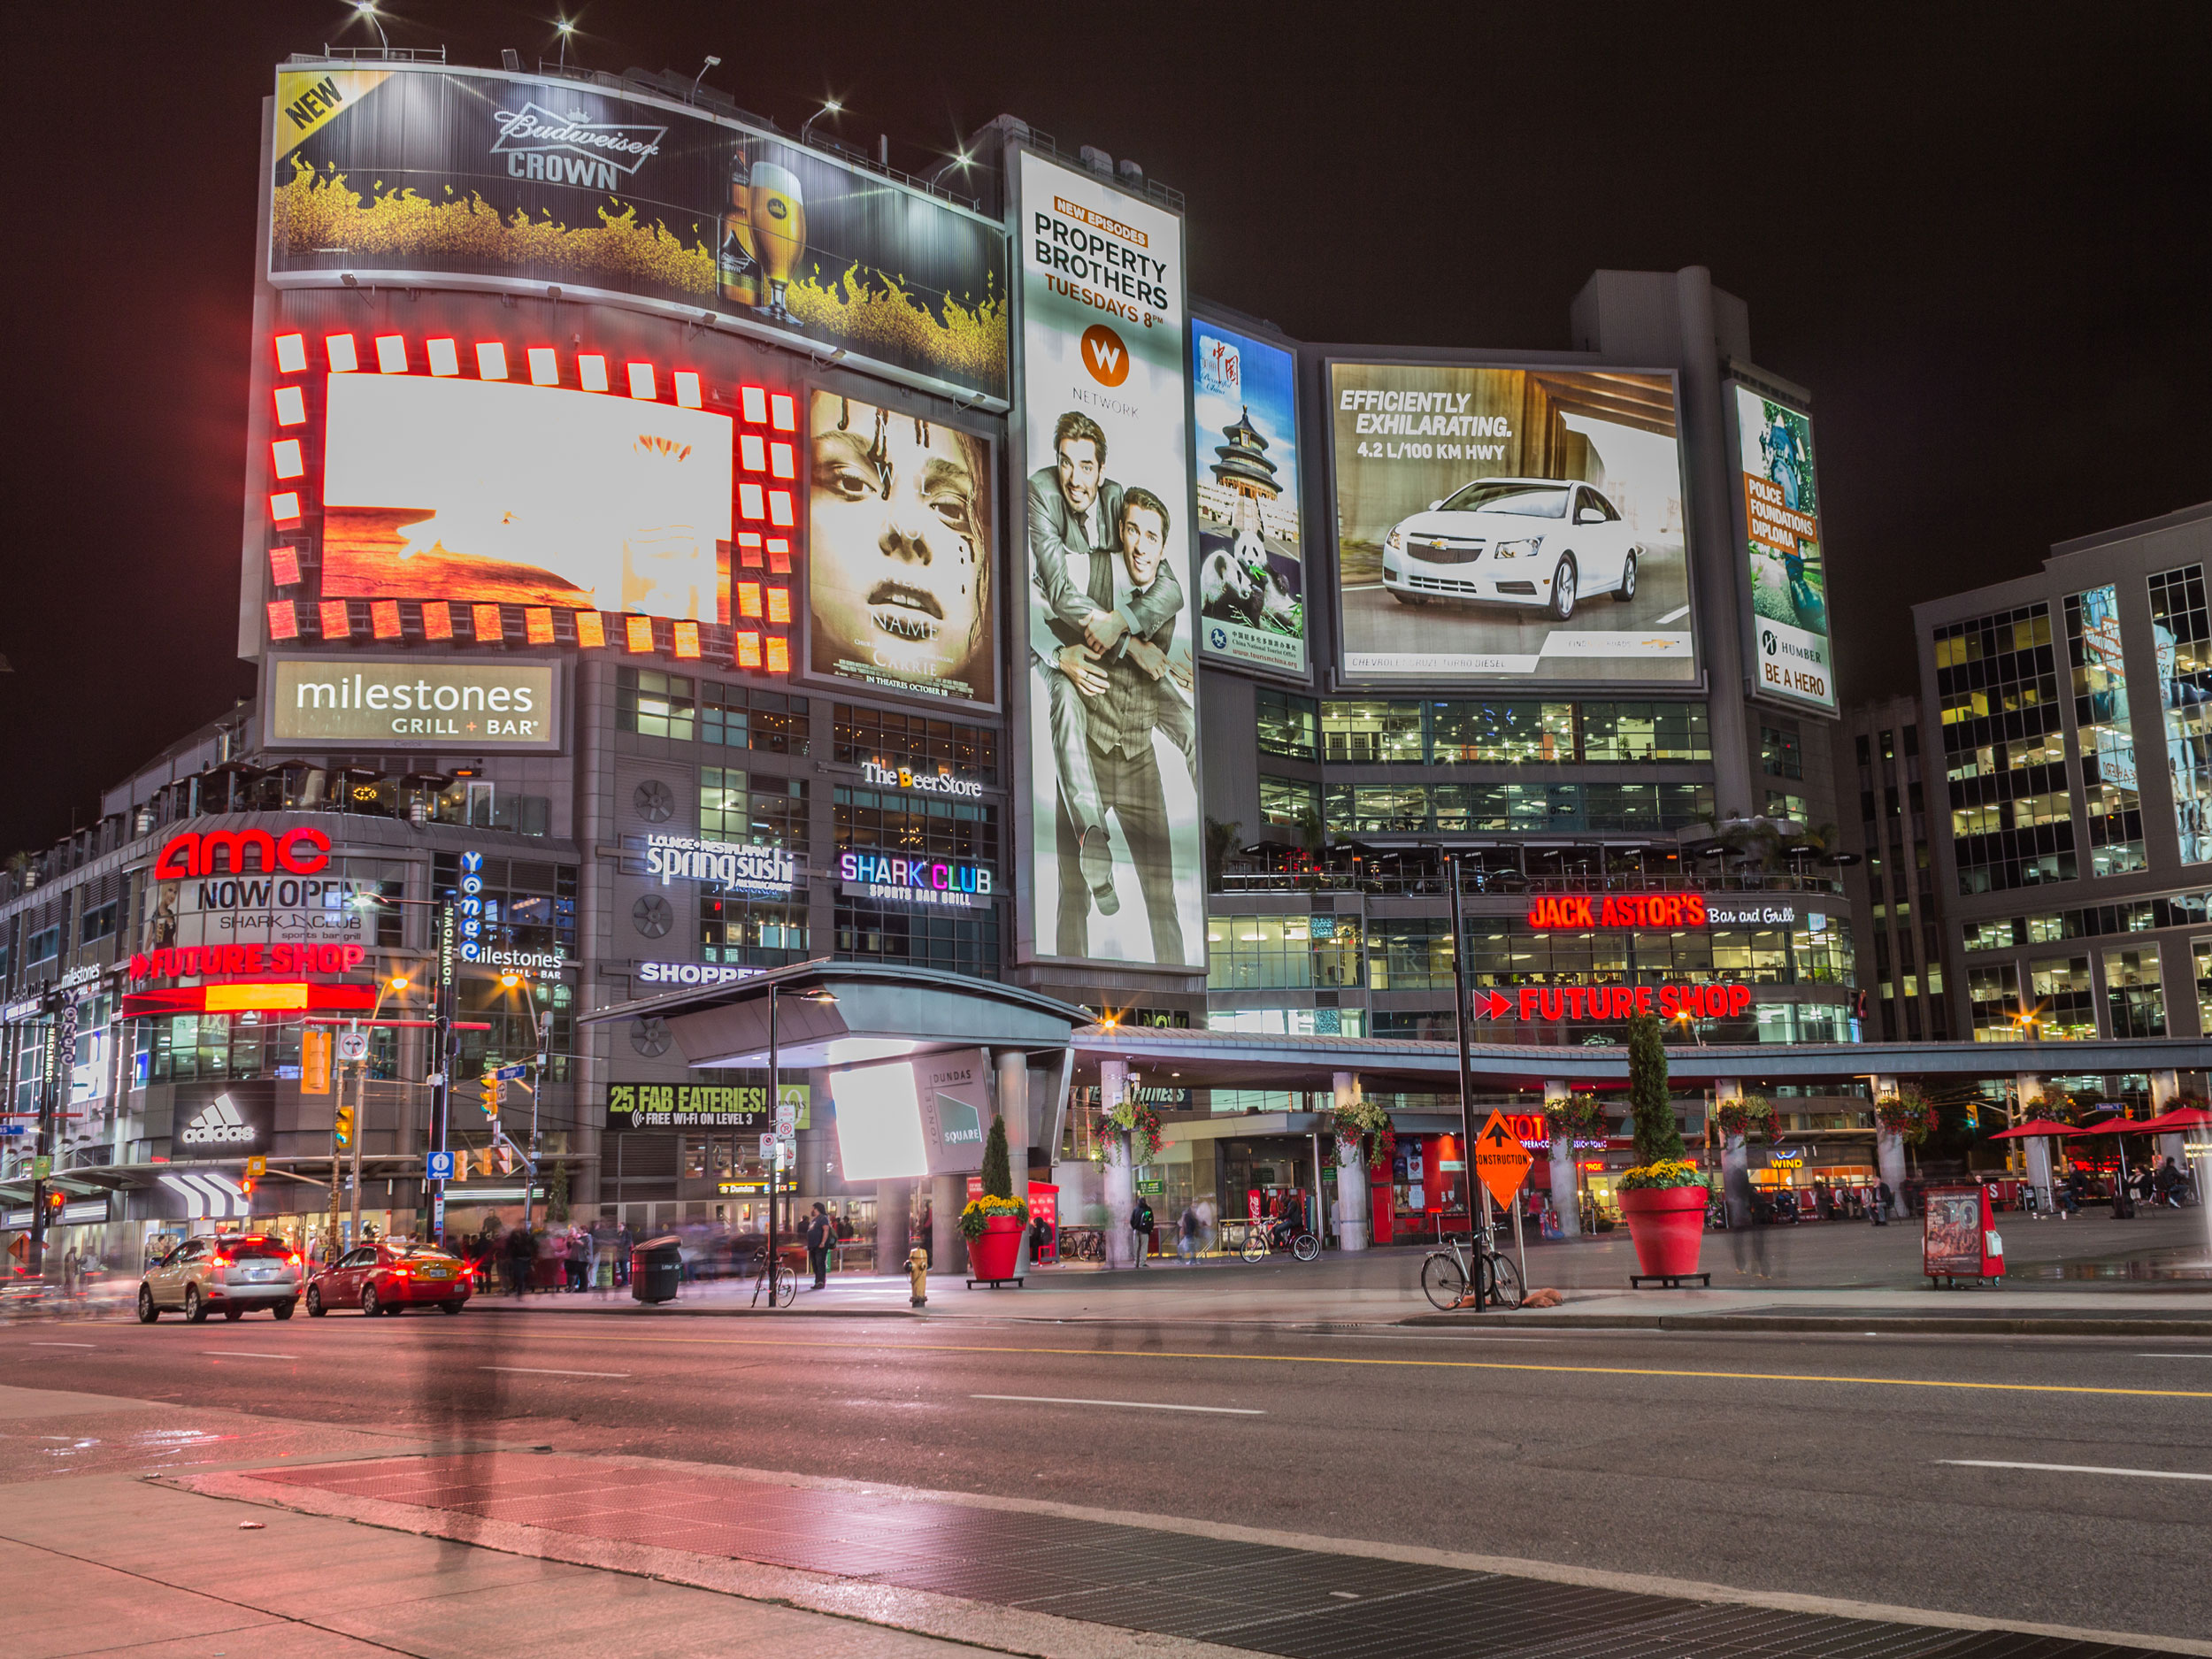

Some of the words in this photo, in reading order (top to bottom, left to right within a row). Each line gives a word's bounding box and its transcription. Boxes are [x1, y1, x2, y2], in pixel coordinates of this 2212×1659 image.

[285, 76, 343, 130] NEW
[495, 110, 658, 157] Budweiser
[508, 151, 617, 190] CROWN
[1057, 198, 1086, 220] NEW
[1088, 211, 1146, 245] EPISODES
[1035, 211, 1167, 283] PROPERTY
[1035, 240, 1168, 310] BROTHERS
[1045, 273, 1138, 323] TUESDAYS
[1090, 339, 1120, 373] W
[1072, 388, 1139, 419] NETWORK
[1340, 389, 1471, 413] EFFICIENTLY
[1356, 413, 1512, 437] EXHILARATING.
[1357, 442, 1383, 457] 4.2
[1387, 443, 1432, 459] L/100
[1437, 444, 1461, 459] KM
[1466, 445, 1505, 460] HWY
[1748, 479, 1782, 507] POLICE
[1750, 499, 1813, 537] FOUNDATIONS
[1752, 518, 1794, 549] DIPLOMA
[870, 611, 939, 641] NAME
[872, 649, 938, 677] CARRIE
[1233, 649, 1298, 670] www.tourismchina.org
[1248, 642, 1265, 651] National
[1267, 646, 1282, 655] Tourist
[1283, 649, 1297, 658] Office
[1782, 642, 1821, 664] HUMBER
[297, 674, 533, 712] milestones
[877, 677, 908, 689] THEATRES
[910, 681, 941, 695] OCTOBER
[941, 688, 949, 697] 18
[1765, 663, 1781, 685] BE
[1784, 668, 1792, 687] A
[1794, 670, 1824, 697] HERO
[391, 718, 459, 733] GRILL
[487, 719, 534, 735] BAR
[862, 761, 897, 786] The
[897, 767, 940, 791] Beer
[940, 773, 982, 796] Store
[648, 834, 695, 850] LOUNGE
[841, 854, 925, 887] SHARK
[932, 864, 991, 895] CLUB
[198, 880, 272, 910] NOW
[279, 880, 361, 908] OPEN
[870, 884, 911, 901] SPORTS
[916, 888, 937, 902] BAR
[941, 891, 971, 906] GRILL
[220, 915, 282, 929] SHARK
[312, 916, 361, 929] CLUB
[1530, 896, 1594, 928] JACK
[1602, 893, 1705, 926] ASTOR'S
[1708, 908, 1736, 923] Bar
[1740, 908, 1759, 923] and
[1763, 907, 1794, 923] Grill
[281, 932, 317, 941] sports
[442, 907, 454, 986] DOWNTOWN
[151, 944, 264, 979] FUTURE
[271, 943, 365, 973] SHOP
[463, 946, 562, 968] ilestones
[62, 963, 100, 988] milestones
[541, 970, 561, 979] BAR
[1518, 987, 1653, 1020] FUTURE
[1660, 985, 1751, 1019] SHOP
[46, 1027, 55, 1084] DOWNTOWN
[933, 1070, 972, 1083] DUNDAS
[610, 1086, 634, 1112] 25
[639, 1087, 673, 1112] FAB
[678, 1087, 766, 1113] EATERIES!
[646, 1113, 671, 1125] FREE
[700, 1112, 713, 1125] ON
[717, 1112, 744, 1125] LEVEL
[746, 1112, 753, 1125] 3
[926, 1096, 938, 1145] YONGE
[182, 1124, 255, 1143] adidas
[944, 1128, 979, 1143] SQUARE
[1476, 1154, 1528, 1165] ONSTRUCTION
[1770, 1159, 1803, 1168] WIND
[1947, 1201, 1978, 1230] 10
